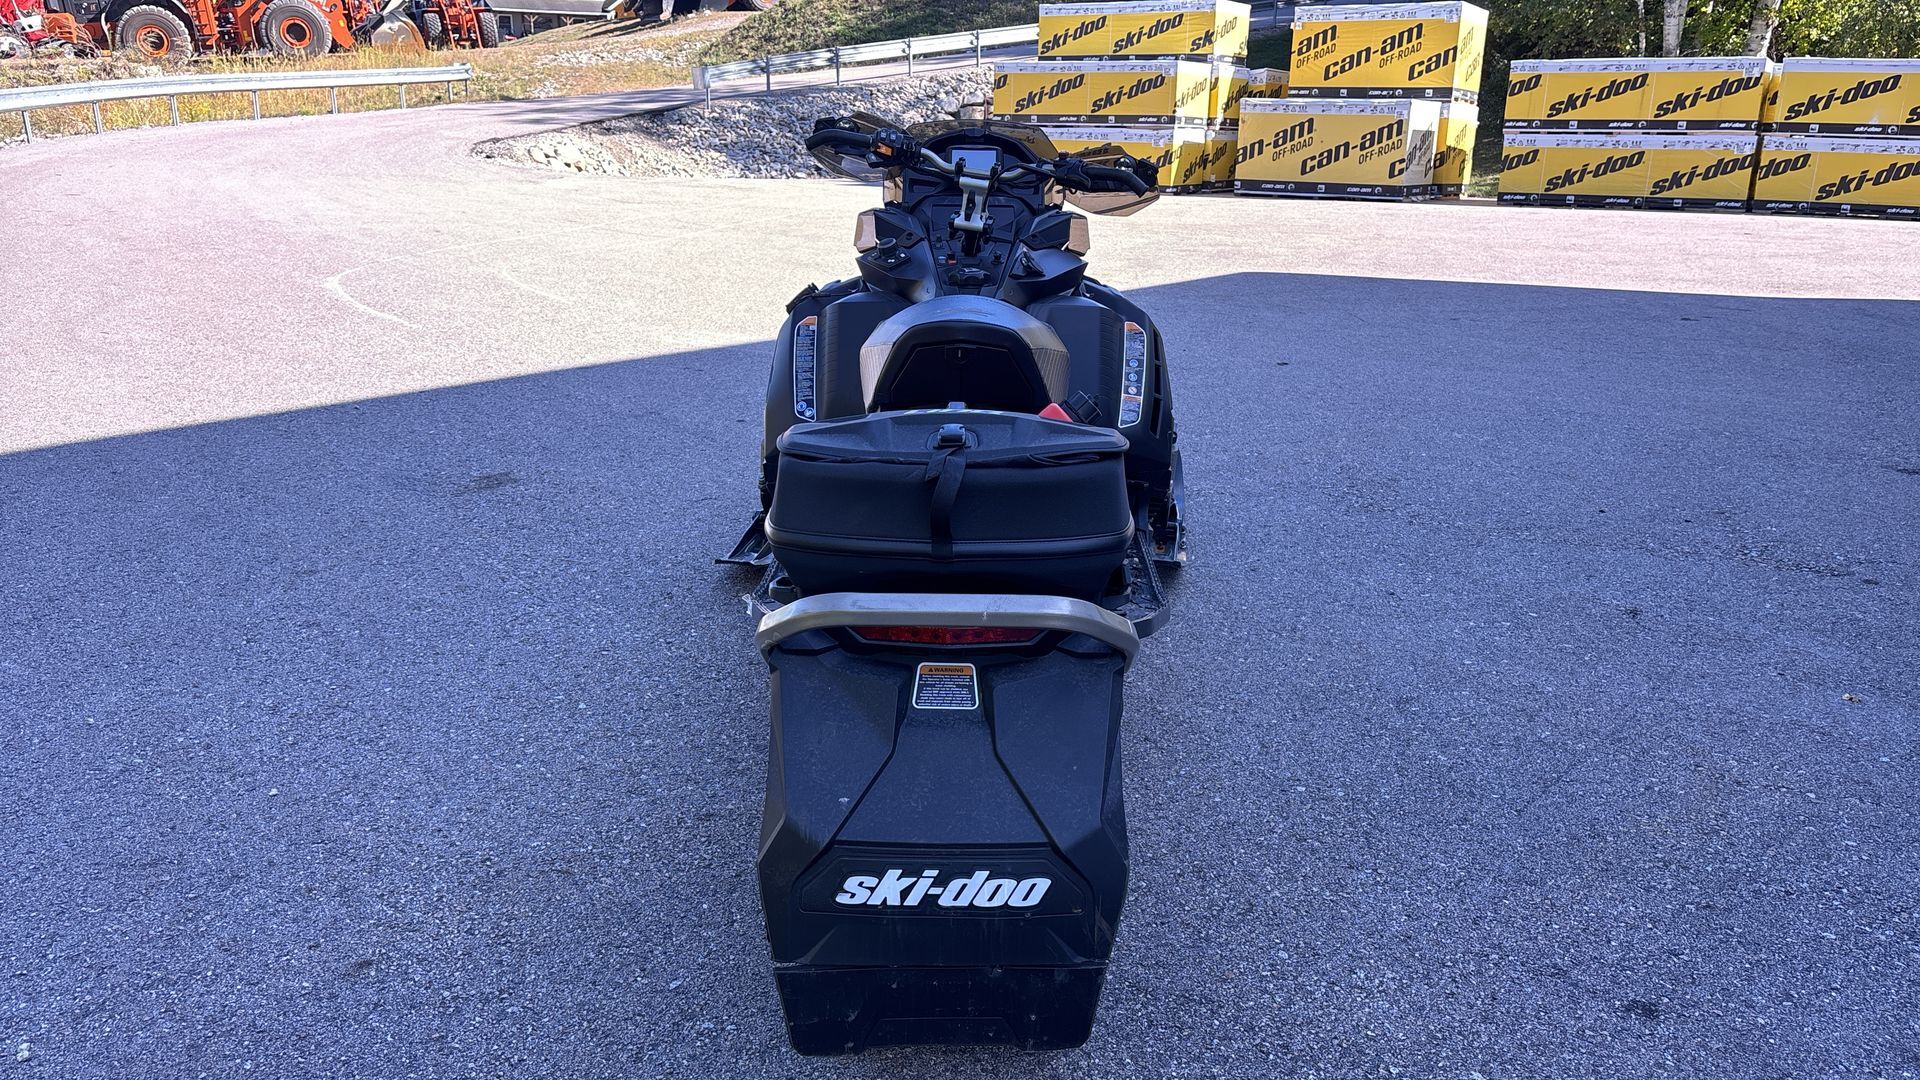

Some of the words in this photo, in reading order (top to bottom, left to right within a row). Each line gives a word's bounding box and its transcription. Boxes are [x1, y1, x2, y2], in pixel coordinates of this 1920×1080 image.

[1040, 15, 1107, 55] ski-doo
[1112, 13, 1184, 54] ski-doo
[1323, 22, 1424, 82] can-am
[1296, 43, 1337, 69] OFF-ROAD
[1379, 41, 1422, 69] OFF-ROAD
[1014, 73, 1085, 114] ski-doo
[1090, 73, 1166, 114] ski-doo
[1508, 74, 1543, 97] oo
[1546, 73, 1650, 118] ski-doo
[1653, 72, 1764, 119] ski-doo
[1784, 74, 1902, 121] ski-doo
[1272, 136, 1314, 162] OFF-ROAD
[1300, 118, 1404, 176] can-am
[1358, 139, 1403, 165] OFF-ROAD
[1544, 151, 1646, 193] ski-doo
[1650, 153, 1756, 196] ski-doo
[835, 869, 1052, 907] ski-doo
